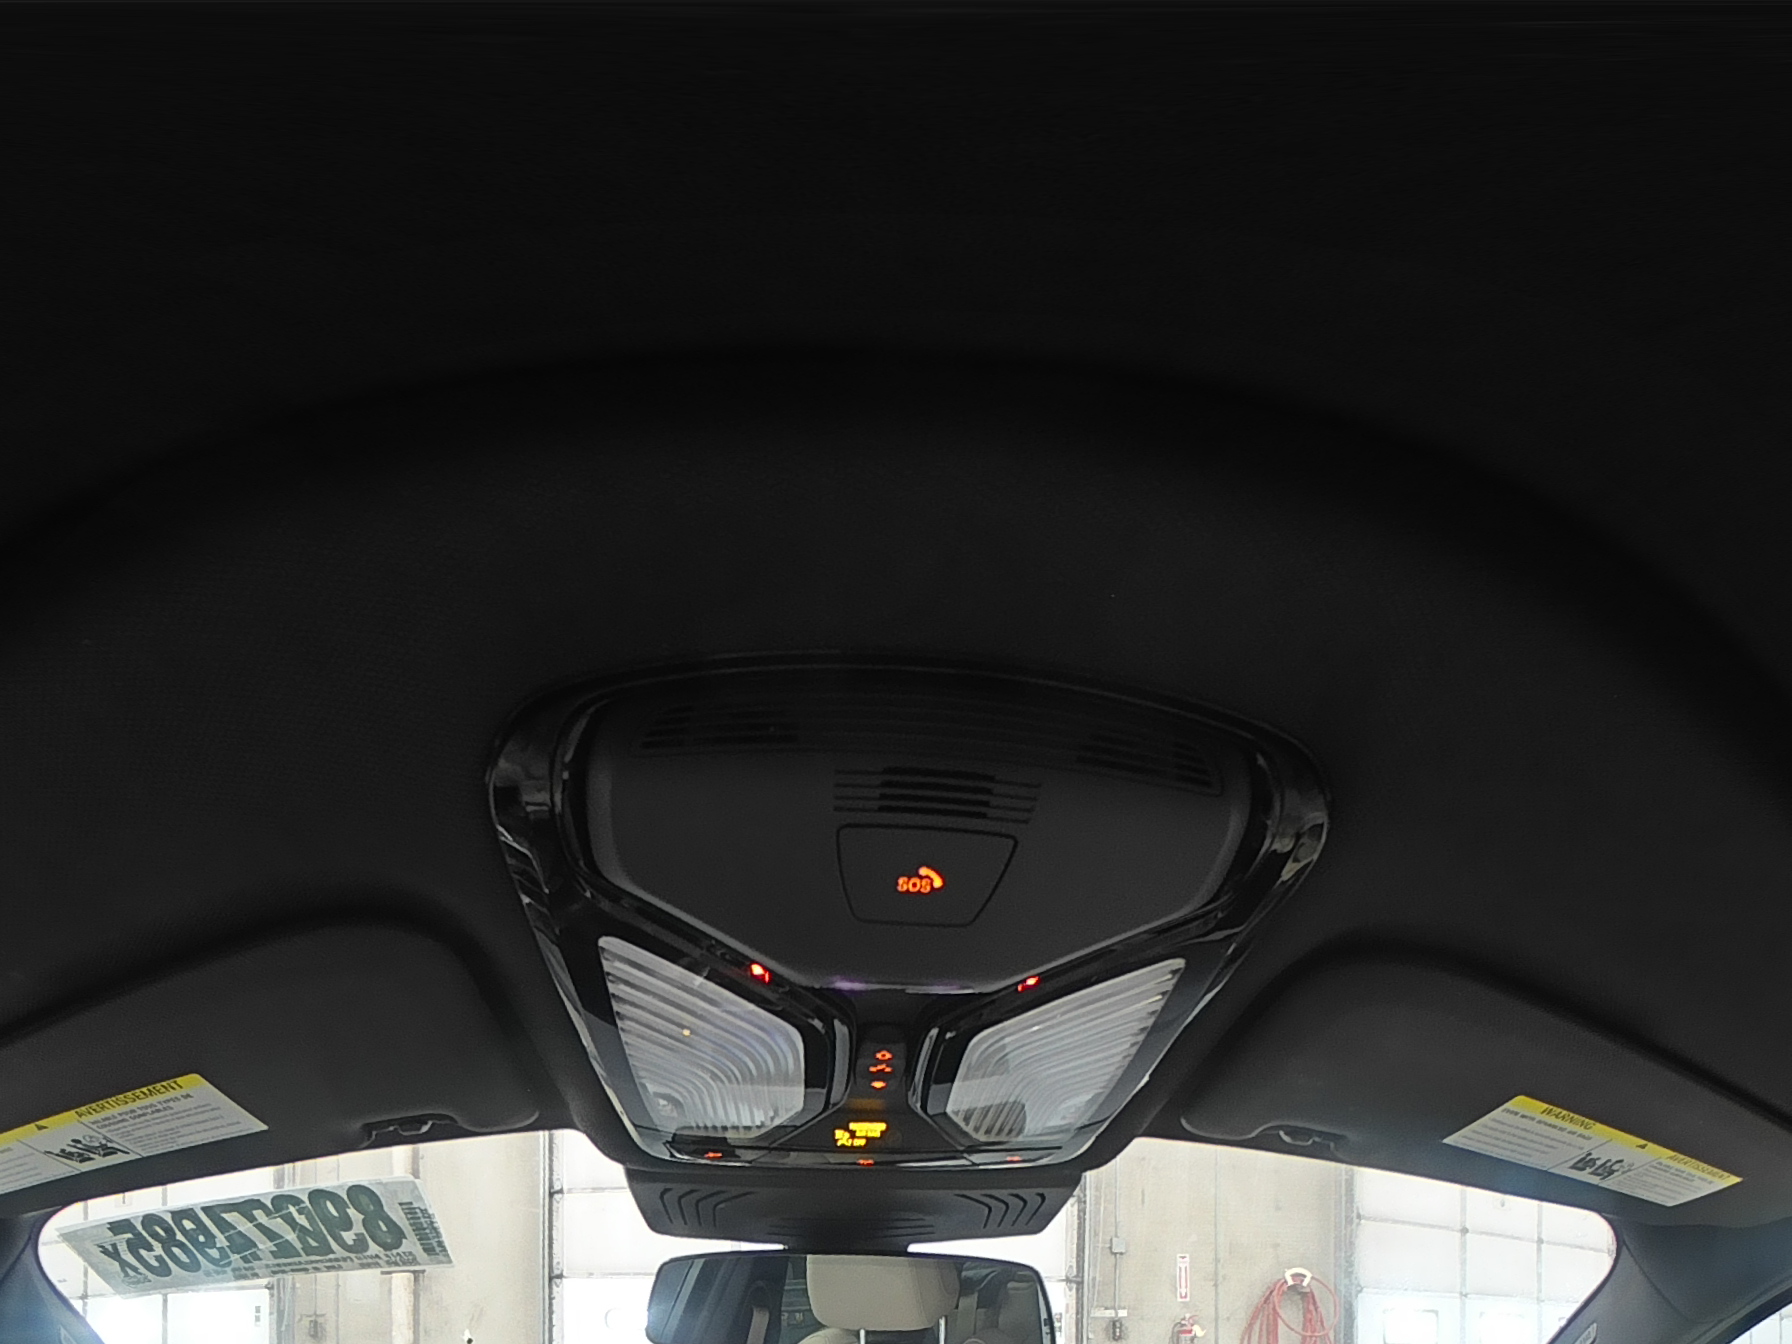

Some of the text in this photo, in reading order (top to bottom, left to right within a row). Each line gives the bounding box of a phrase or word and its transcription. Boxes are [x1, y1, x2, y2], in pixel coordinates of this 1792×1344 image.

[897, 876, 932, 893] SOS
[75, 1080, 184, 1119] AVERTISSEMENT
[1540, 1105, 1597, 1132] WARNING
